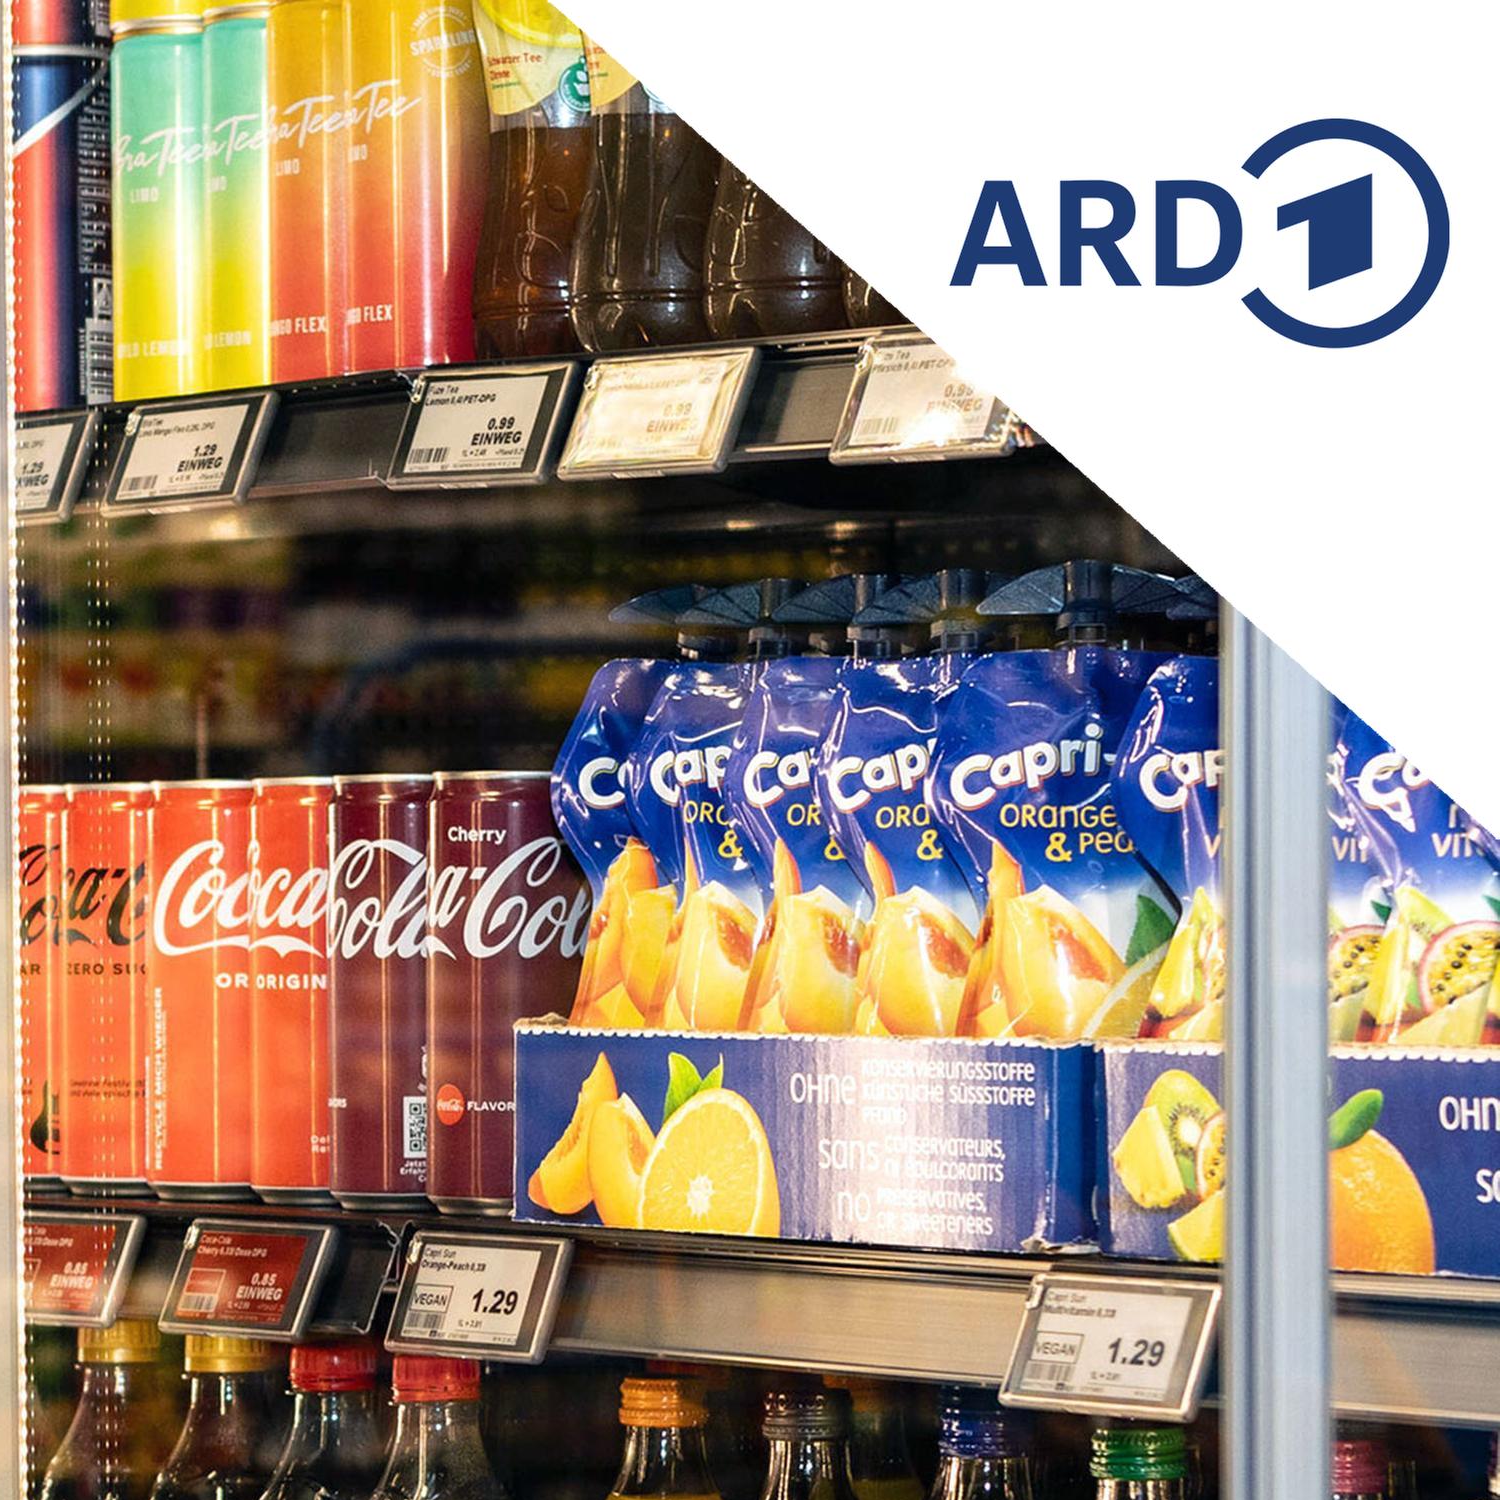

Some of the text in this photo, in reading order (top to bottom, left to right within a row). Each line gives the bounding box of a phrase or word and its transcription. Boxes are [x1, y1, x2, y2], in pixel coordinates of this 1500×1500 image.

[363, 303, 392, 323] FLEX
[487, 416, 515, 431] 0.99
[471, 431, 522, 447] EINWEG
[193, 444, 218, 458] 1.29
[177, 456, 223, 473] EINWEG
[448, 826, 507, 846] Cherry
[1045, 832, 1072, 862] &
[50, 1274, 93, 1288] EINWEG
[251, 1272, 275, 1287] 0.85
[236, 1286, 283, 1301] EINWEG
[414, 1292, 447, 1306] VEGAN
[472, 1288, 518, 1315] 1.29
[1035, 1341, 1076, 1356] VEGAN
[1108, 1337, 1166, 1367] 1.29
